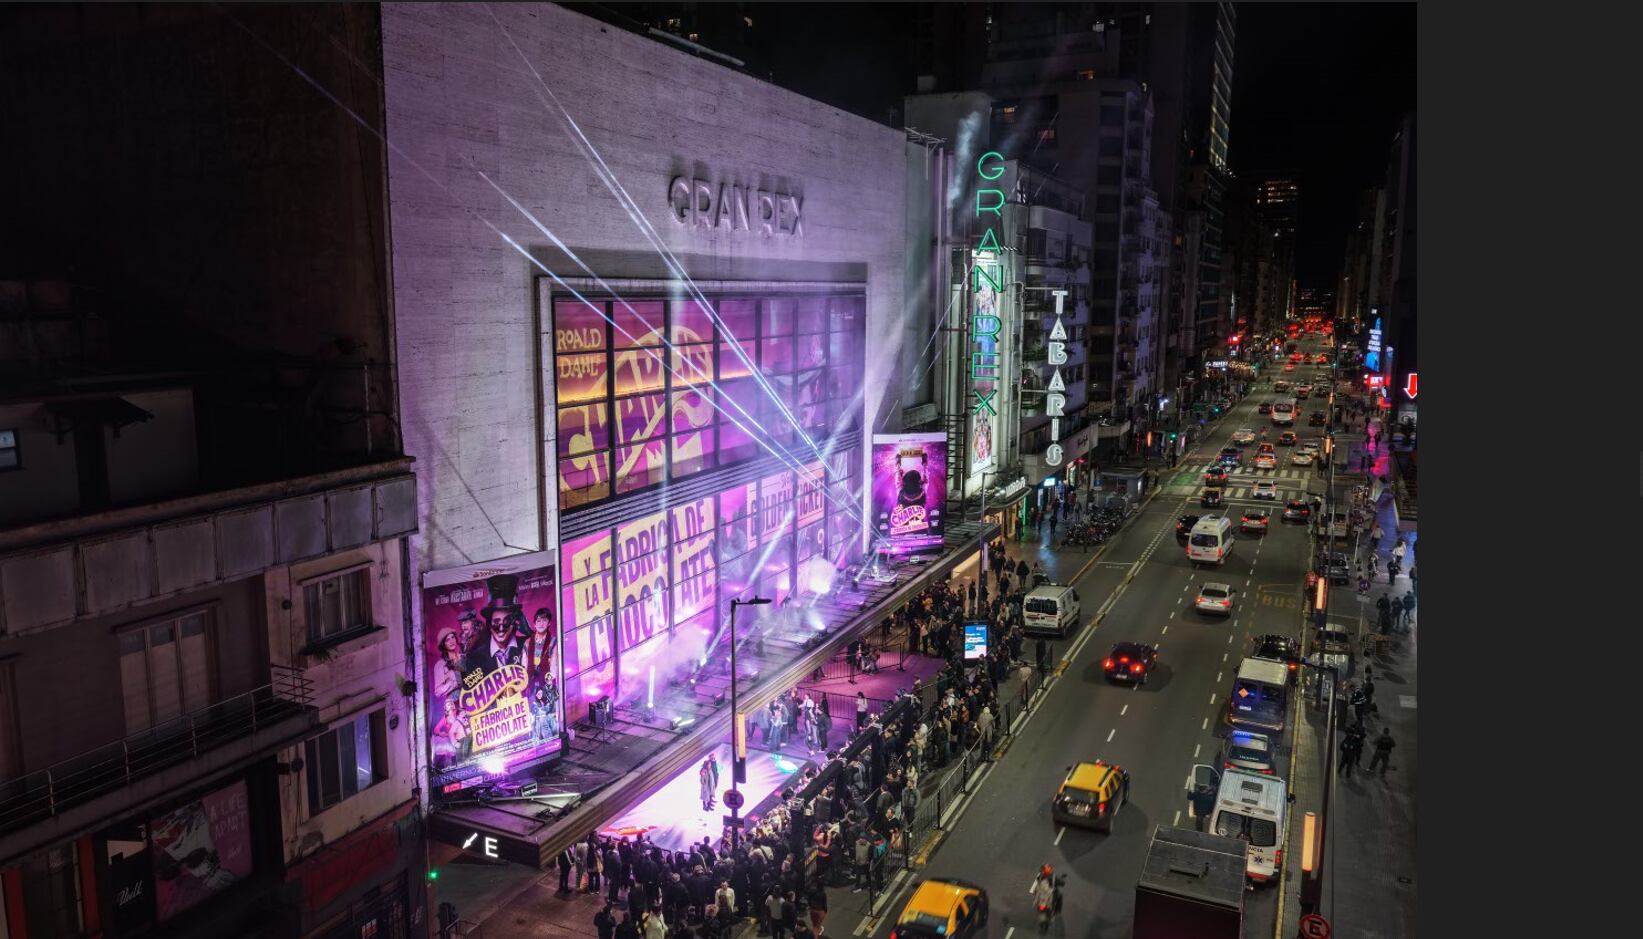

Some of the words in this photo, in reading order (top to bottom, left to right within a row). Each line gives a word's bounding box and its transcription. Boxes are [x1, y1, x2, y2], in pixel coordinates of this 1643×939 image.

[668, 175, 751, 230] GRAN
[757, 189, 806, 239] REX
[974, 151, 1006, 294] GRAN
[557, 328, 601, 350] ROALD
[972, 315, 1002, 418] REX
[1045, 290, 1068, 466] TABARIS
[584, 557, 591, 576] Y
[585, 583, 599, 611] LA
[685, 500, 705, 547] DE
[1263, 594, 1296, 609] BUS
[462, 666, 526, 711] CHARLIE
[480, 706, 513, 728] FÁBRICA
[516, 701, 525, 715] DE
[475, 715, 528, 747] CHOCOLATE
[220, 793, 245, 814] LIFE
[485, 837, 499, 858] E
[1309, 919, 1323, 937] E
